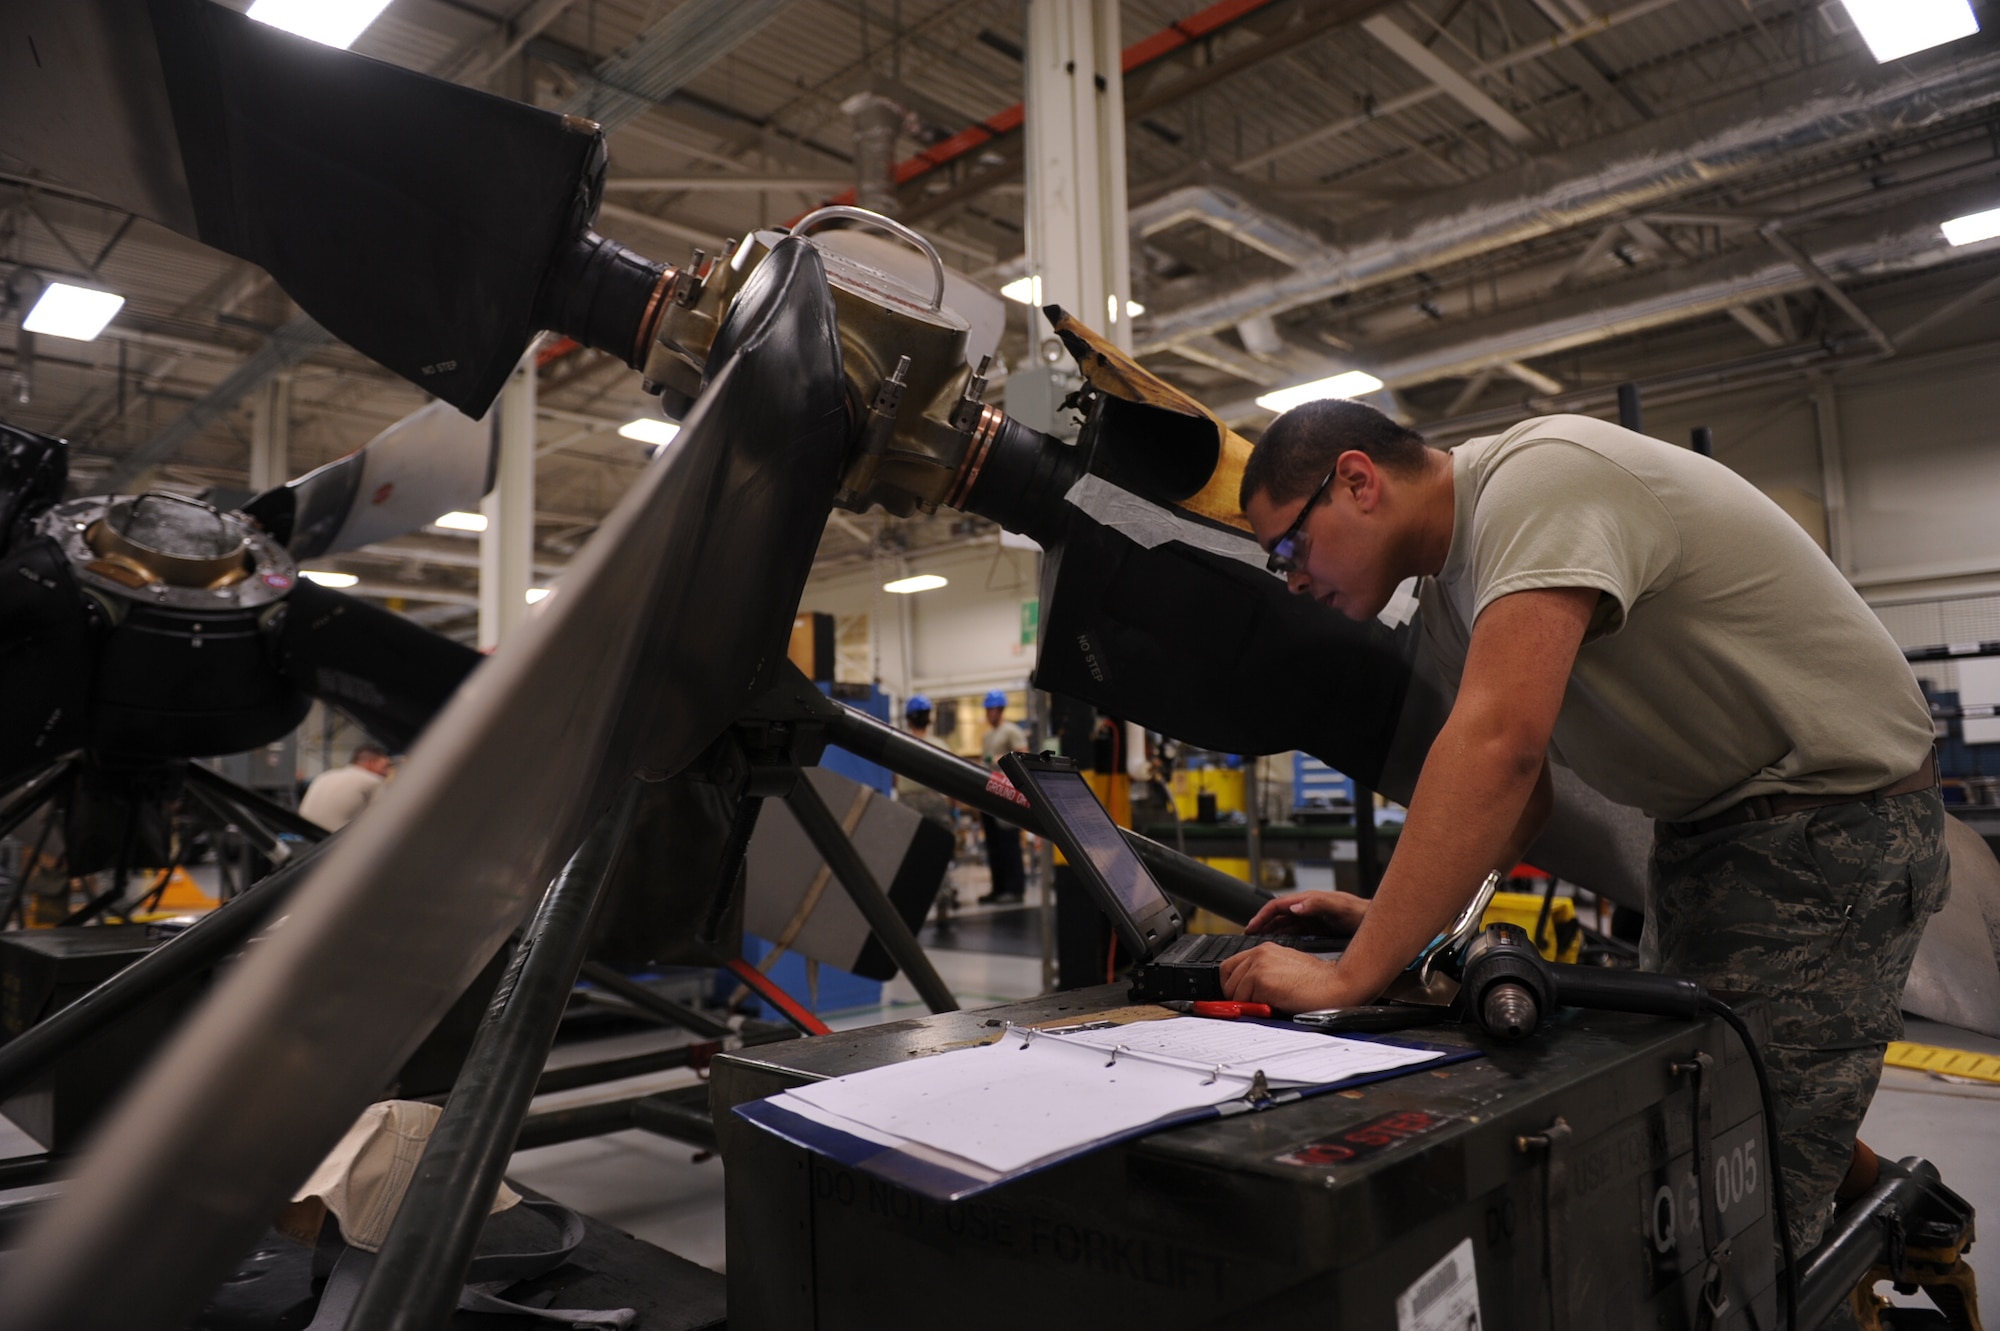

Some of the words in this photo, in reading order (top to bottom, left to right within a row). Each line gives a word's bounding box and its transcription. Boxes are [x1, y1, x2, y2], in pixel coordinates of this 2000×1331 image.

[421, 364, 436, 376] NO
[436, 360, 458, 373] STEP
[1076, 634, 1091, 652] NO
[1085, 653, 1104, 682] STEP
[985, 779, 1017, 801] GROUND
[1345, 1111, 1435, 1146] STEP
[1715, 1138, 1757, 1213] 005
[815, 1166, 856, 1207] DO
[868, 1178, 926, 1226] NOT
[945, 1199, 1013, 1248] USE
[1031, 1216, 1226, 1301] FORKLIFT
